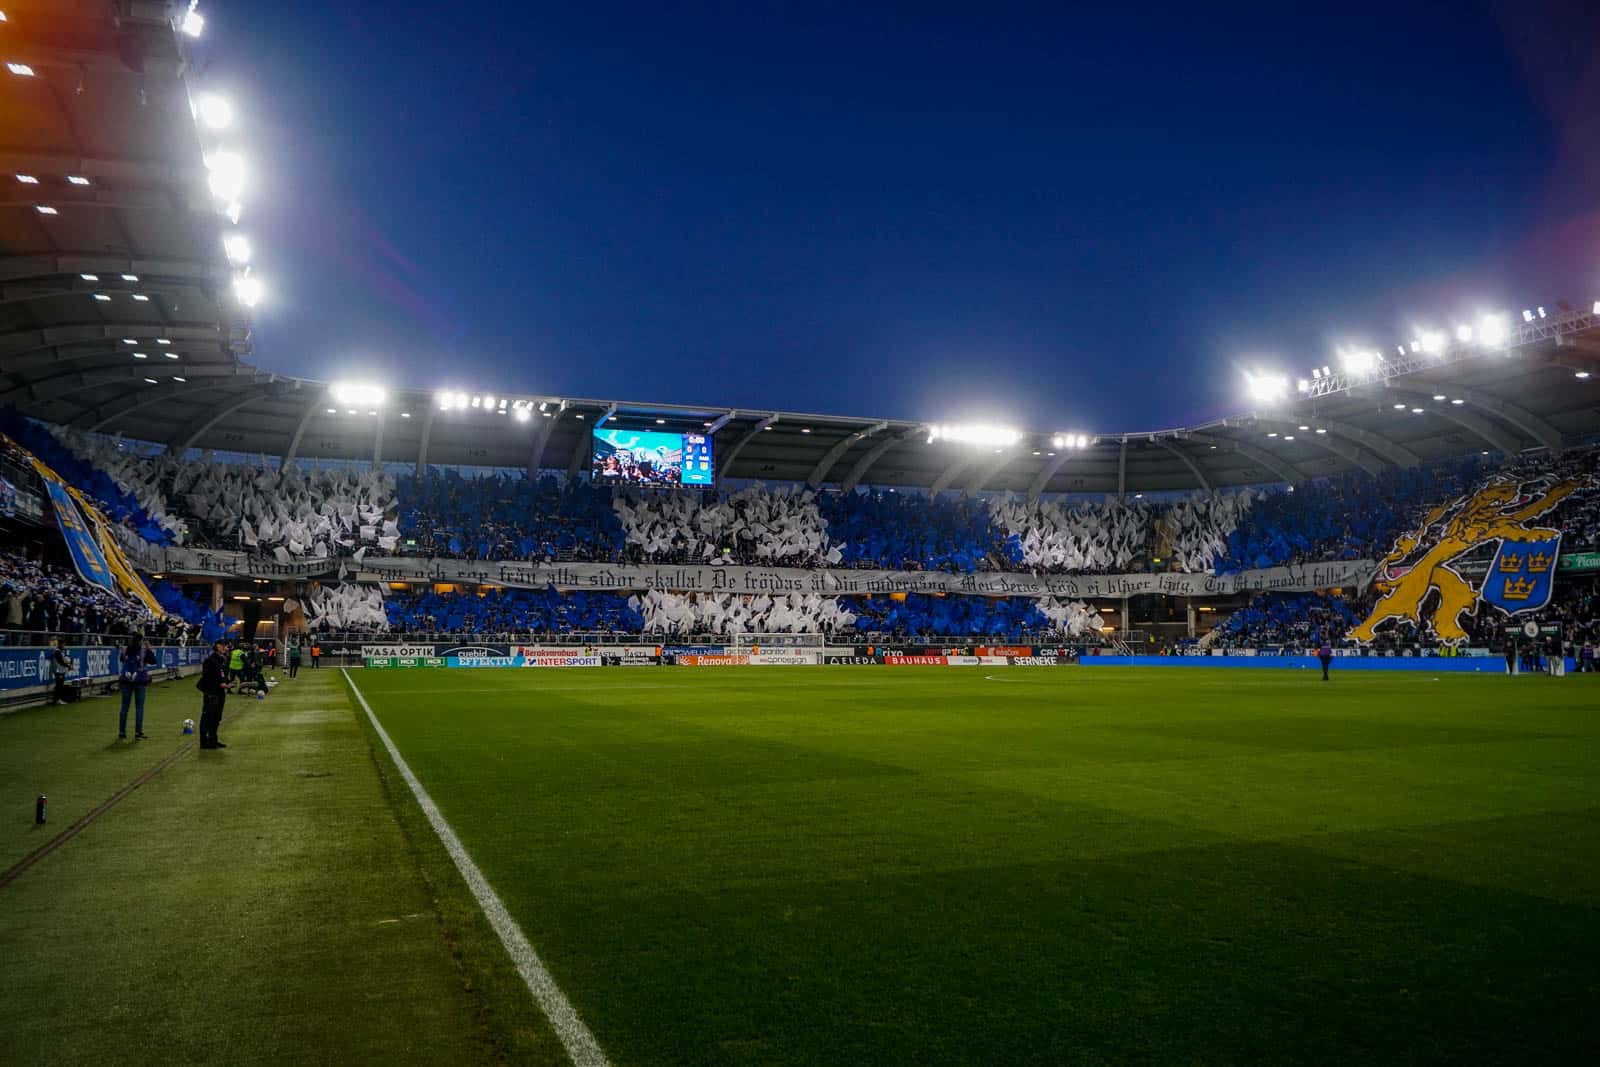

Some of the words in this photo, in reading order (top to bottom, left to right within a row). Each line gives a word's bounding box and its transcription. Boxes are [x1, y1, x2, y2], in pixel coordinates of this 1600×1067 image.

[548, 567, 580, 586] alla
[589, 569, 635, 588] sidor
[645, 569, 703, 589] skalla!
[711, 569, 737, 590] De
[744, 571, 803, 593] fröjdas
[834, 575, 858, 591] din
[866, 575, 947, 593] undergång
[959, 575, 994, 593] Men
[1000, 576, 1040, 594] deras
[1045, 578, 1080, 597] fröjd
[363, 647, 397, 656] WASA
[400, 647, 433, 657] OPTIK
[1040, 648, 1070, 657] CRAT
[459, 657, 514, 666] EFFEKTIV
[537, 657, 597, 666] INTERSPORT
[697, 656, 732, 666] Renova
[842, 656, 877, 665] ELEDA
[892, 657, 942, 665] BAUHAUS
[1014, 656, 1057, 666] SERNEKE
